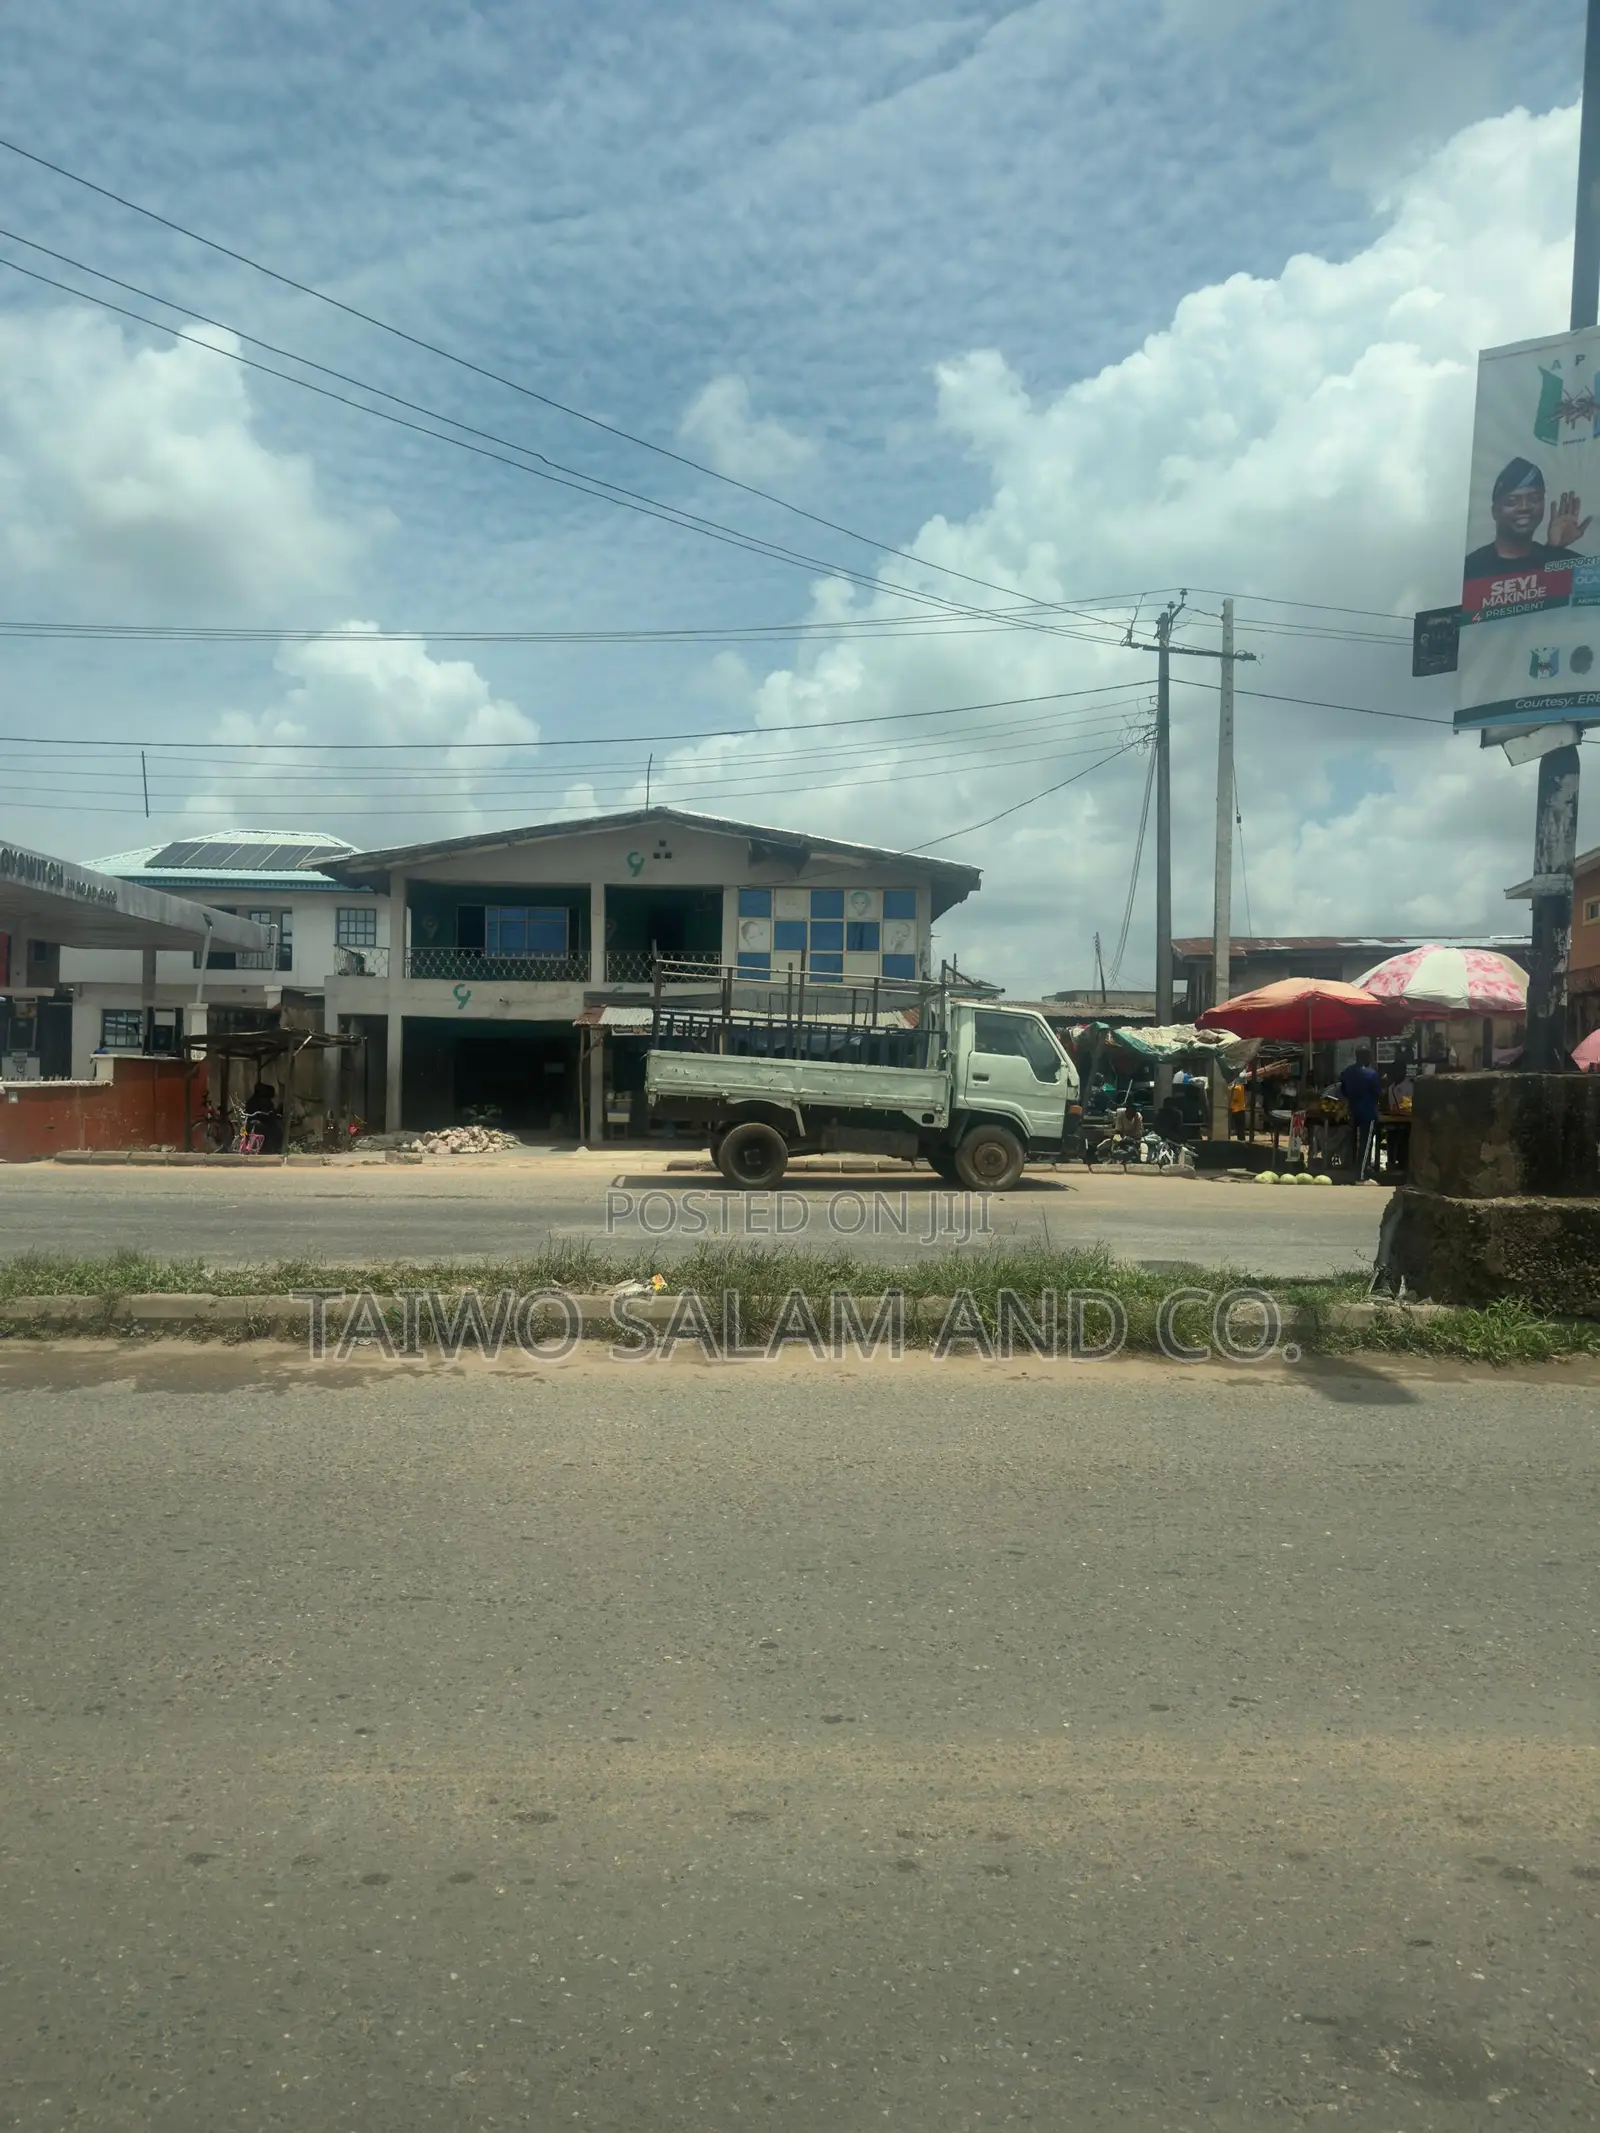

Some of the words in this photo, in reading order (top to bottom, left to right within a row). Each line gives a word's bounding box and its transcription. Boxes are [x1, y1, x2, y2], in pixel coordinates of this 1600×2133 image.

[1490, 574, 1537, 596] SEYI
[1482, 586, 1547, 608] MAKINDE
[1485, 600, 1545, 618] PRESIDENT
